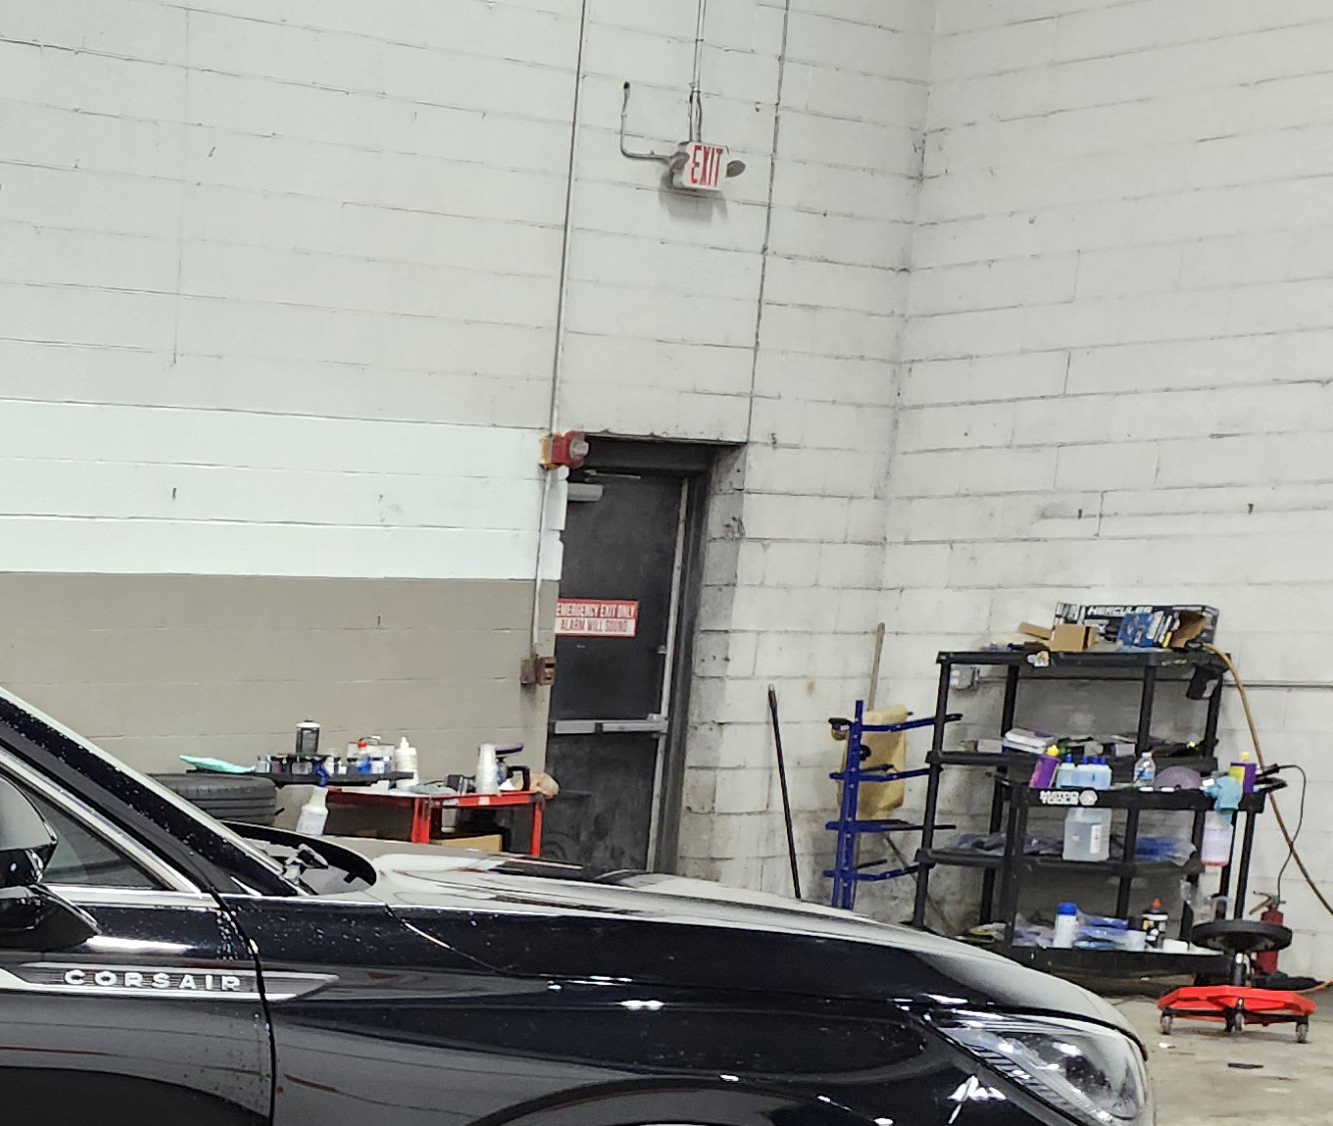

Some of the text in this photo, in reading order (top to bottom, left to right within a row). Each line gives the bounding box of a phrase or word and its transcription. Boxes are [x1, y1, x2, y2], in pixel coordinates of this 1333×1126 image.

[691, 144, 724, 187] EXIT
[557, 601, 636, 619] EMERGENCY EXIT ONLY
[1087, 606, 1154, 617] HERCULES
[560, 618, 628, 632] ALARM WILL SOUND
[63, 968, 241, 991] CORSAIR
